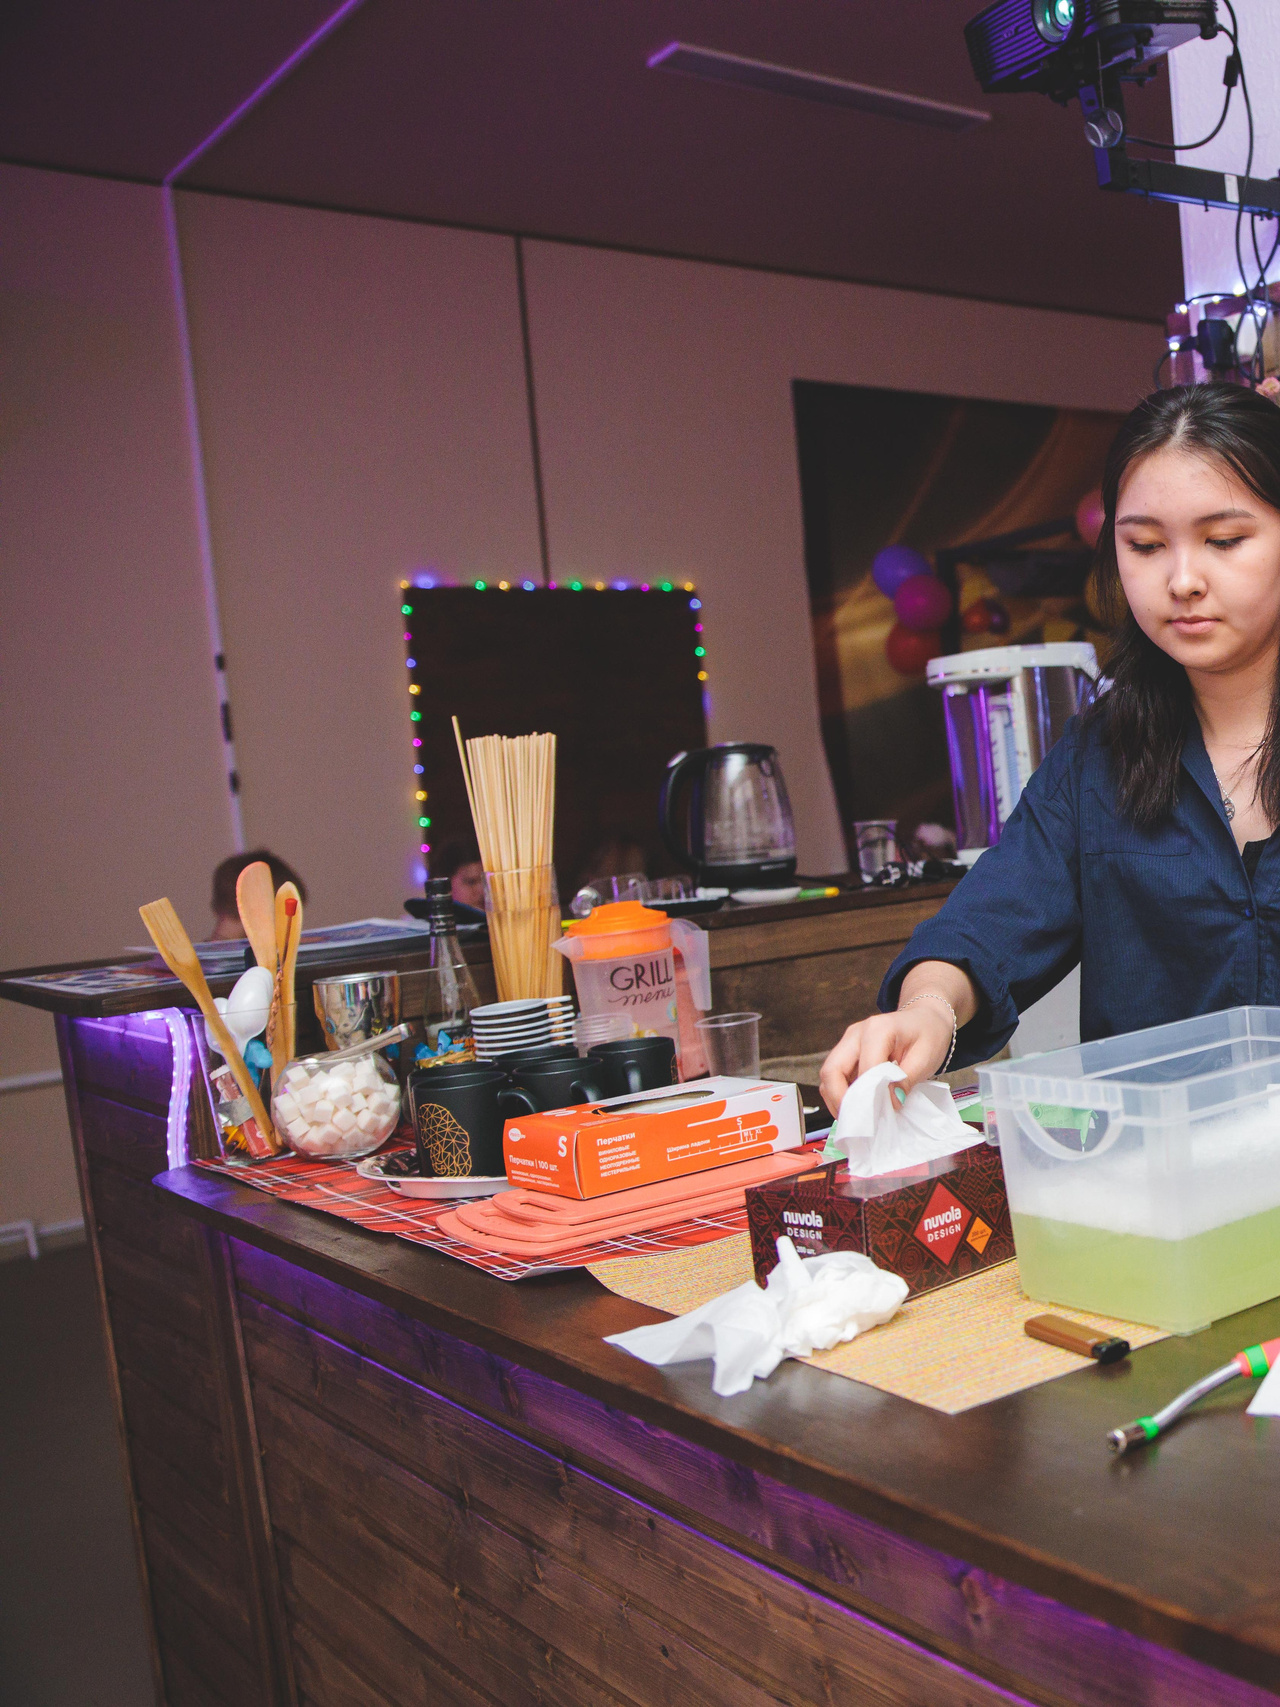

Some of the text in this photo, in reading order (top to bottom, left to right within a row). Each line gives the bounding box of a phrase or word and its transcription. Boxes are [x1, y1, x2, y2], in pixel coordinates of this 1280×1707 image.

[610, 958, 673, 991] GRILL
[608, 988, 675, 1006] menu
[736, 1117, 743, 1126] S
[557, 1135, 568, 1158] S
[596, 1132, 636, 1147] Перчатки
[666, 1139, 711, 1154] Ширина ладони
[508, 1154, 535, 1167] Перчатки
[538, 1160, 549, 1170] 100
[783, 1210, 824, 1228] nuvola
[923, 1205, 962, 1231] nuvola
[786, 1226, 823, 1241] DESIGN
[927, 1223, 962, 1243] DESIGN
